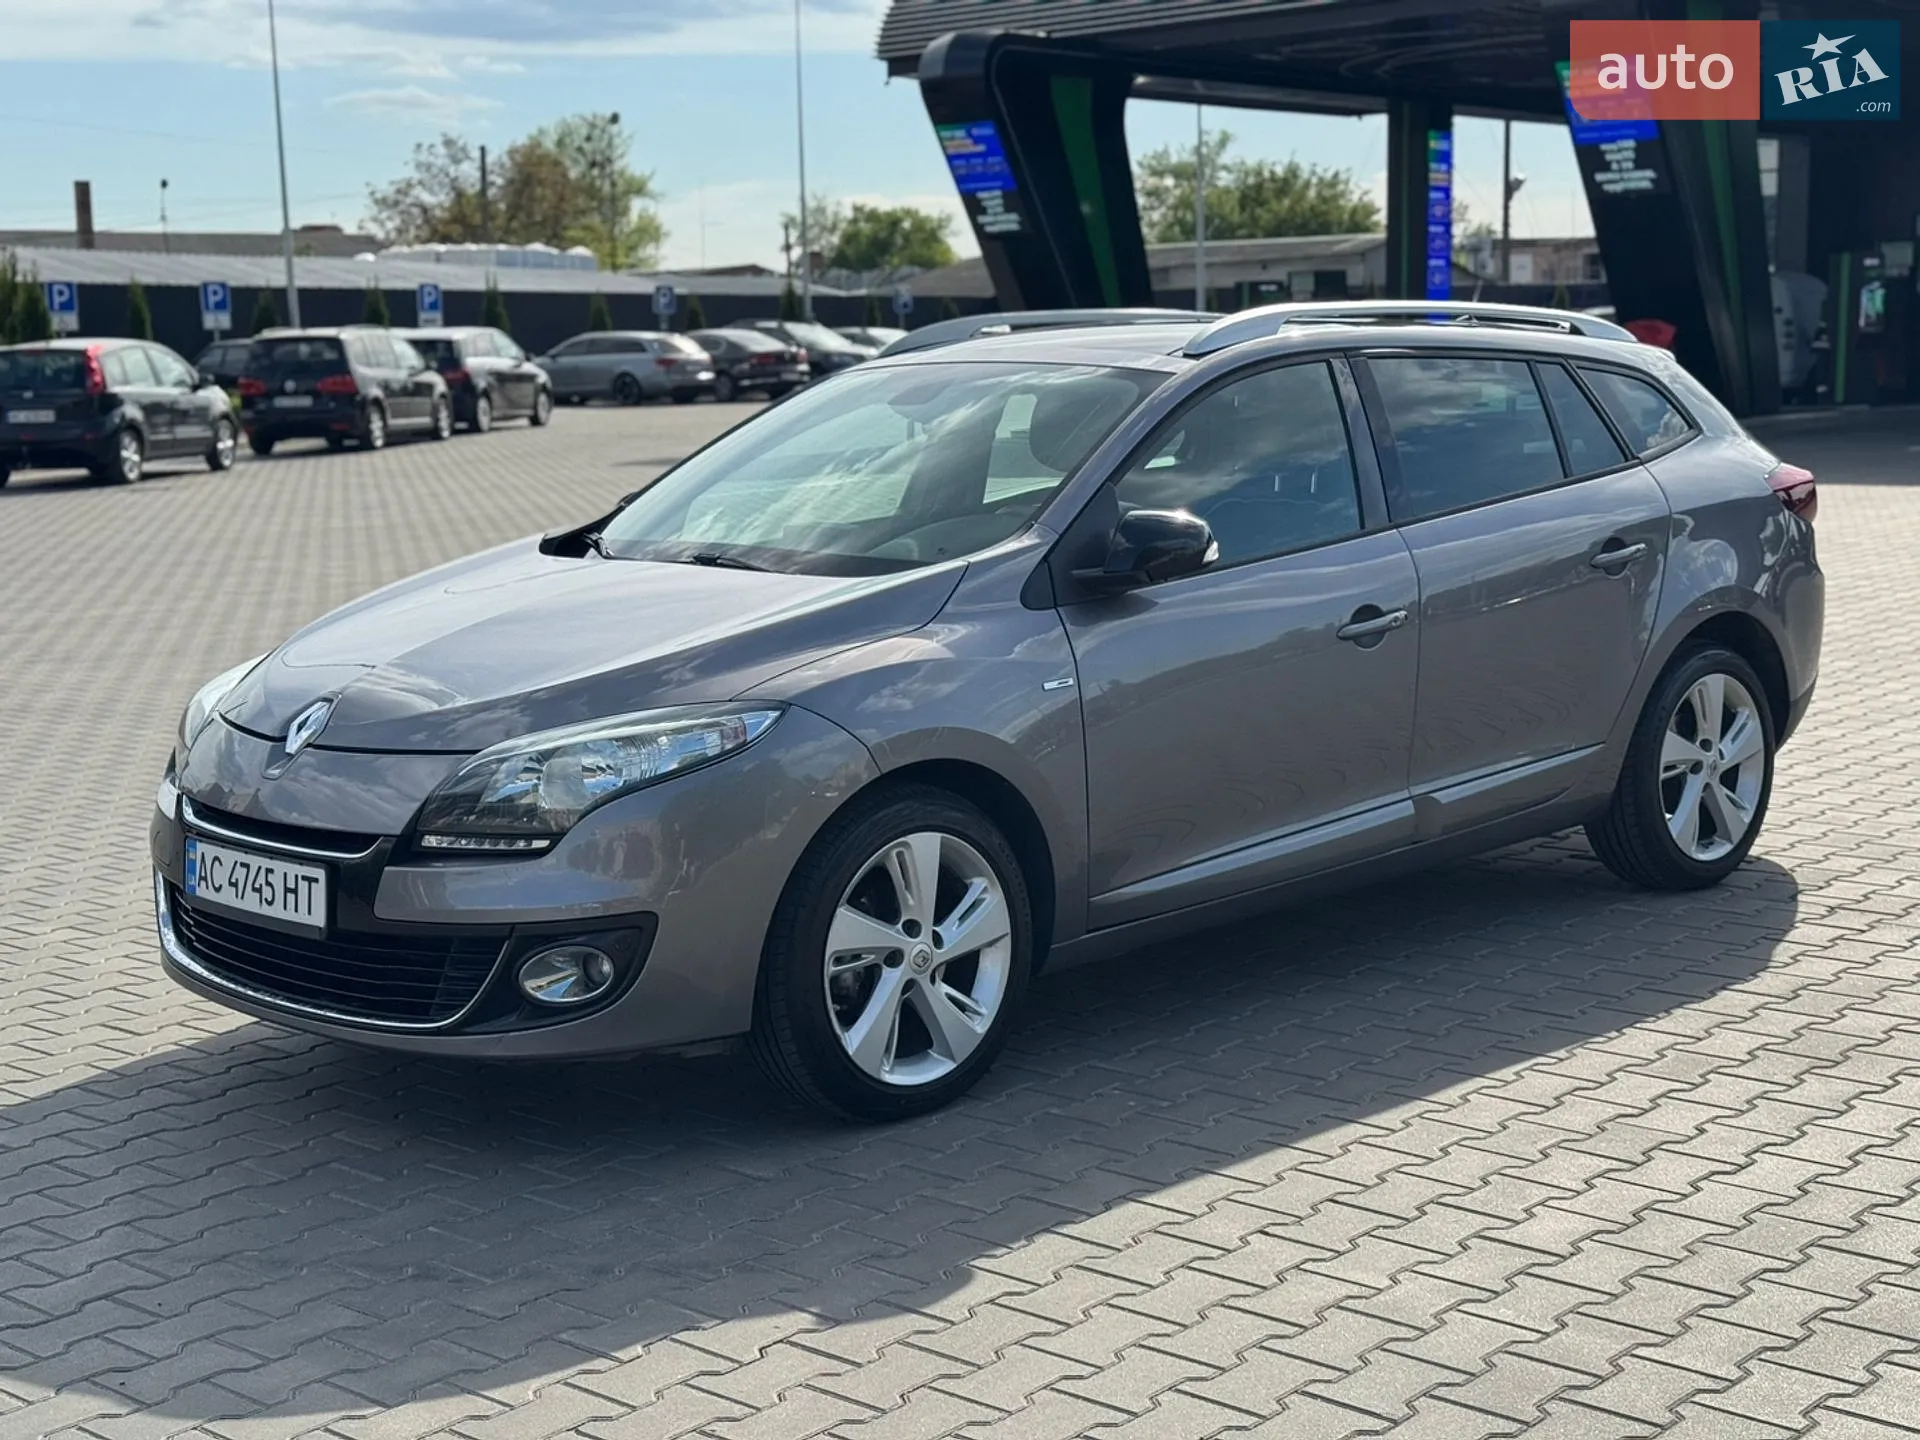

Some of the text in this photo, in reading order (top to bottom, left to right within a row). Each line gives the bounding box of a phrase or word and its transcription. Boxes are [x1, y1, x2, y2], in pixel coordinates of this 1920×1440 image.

[52, 284, 70, 309] P
[207, 284, 224, 309] P
[423, 286, 437, 307] P
[197, 851, 320, 916] AC 4745 HT
